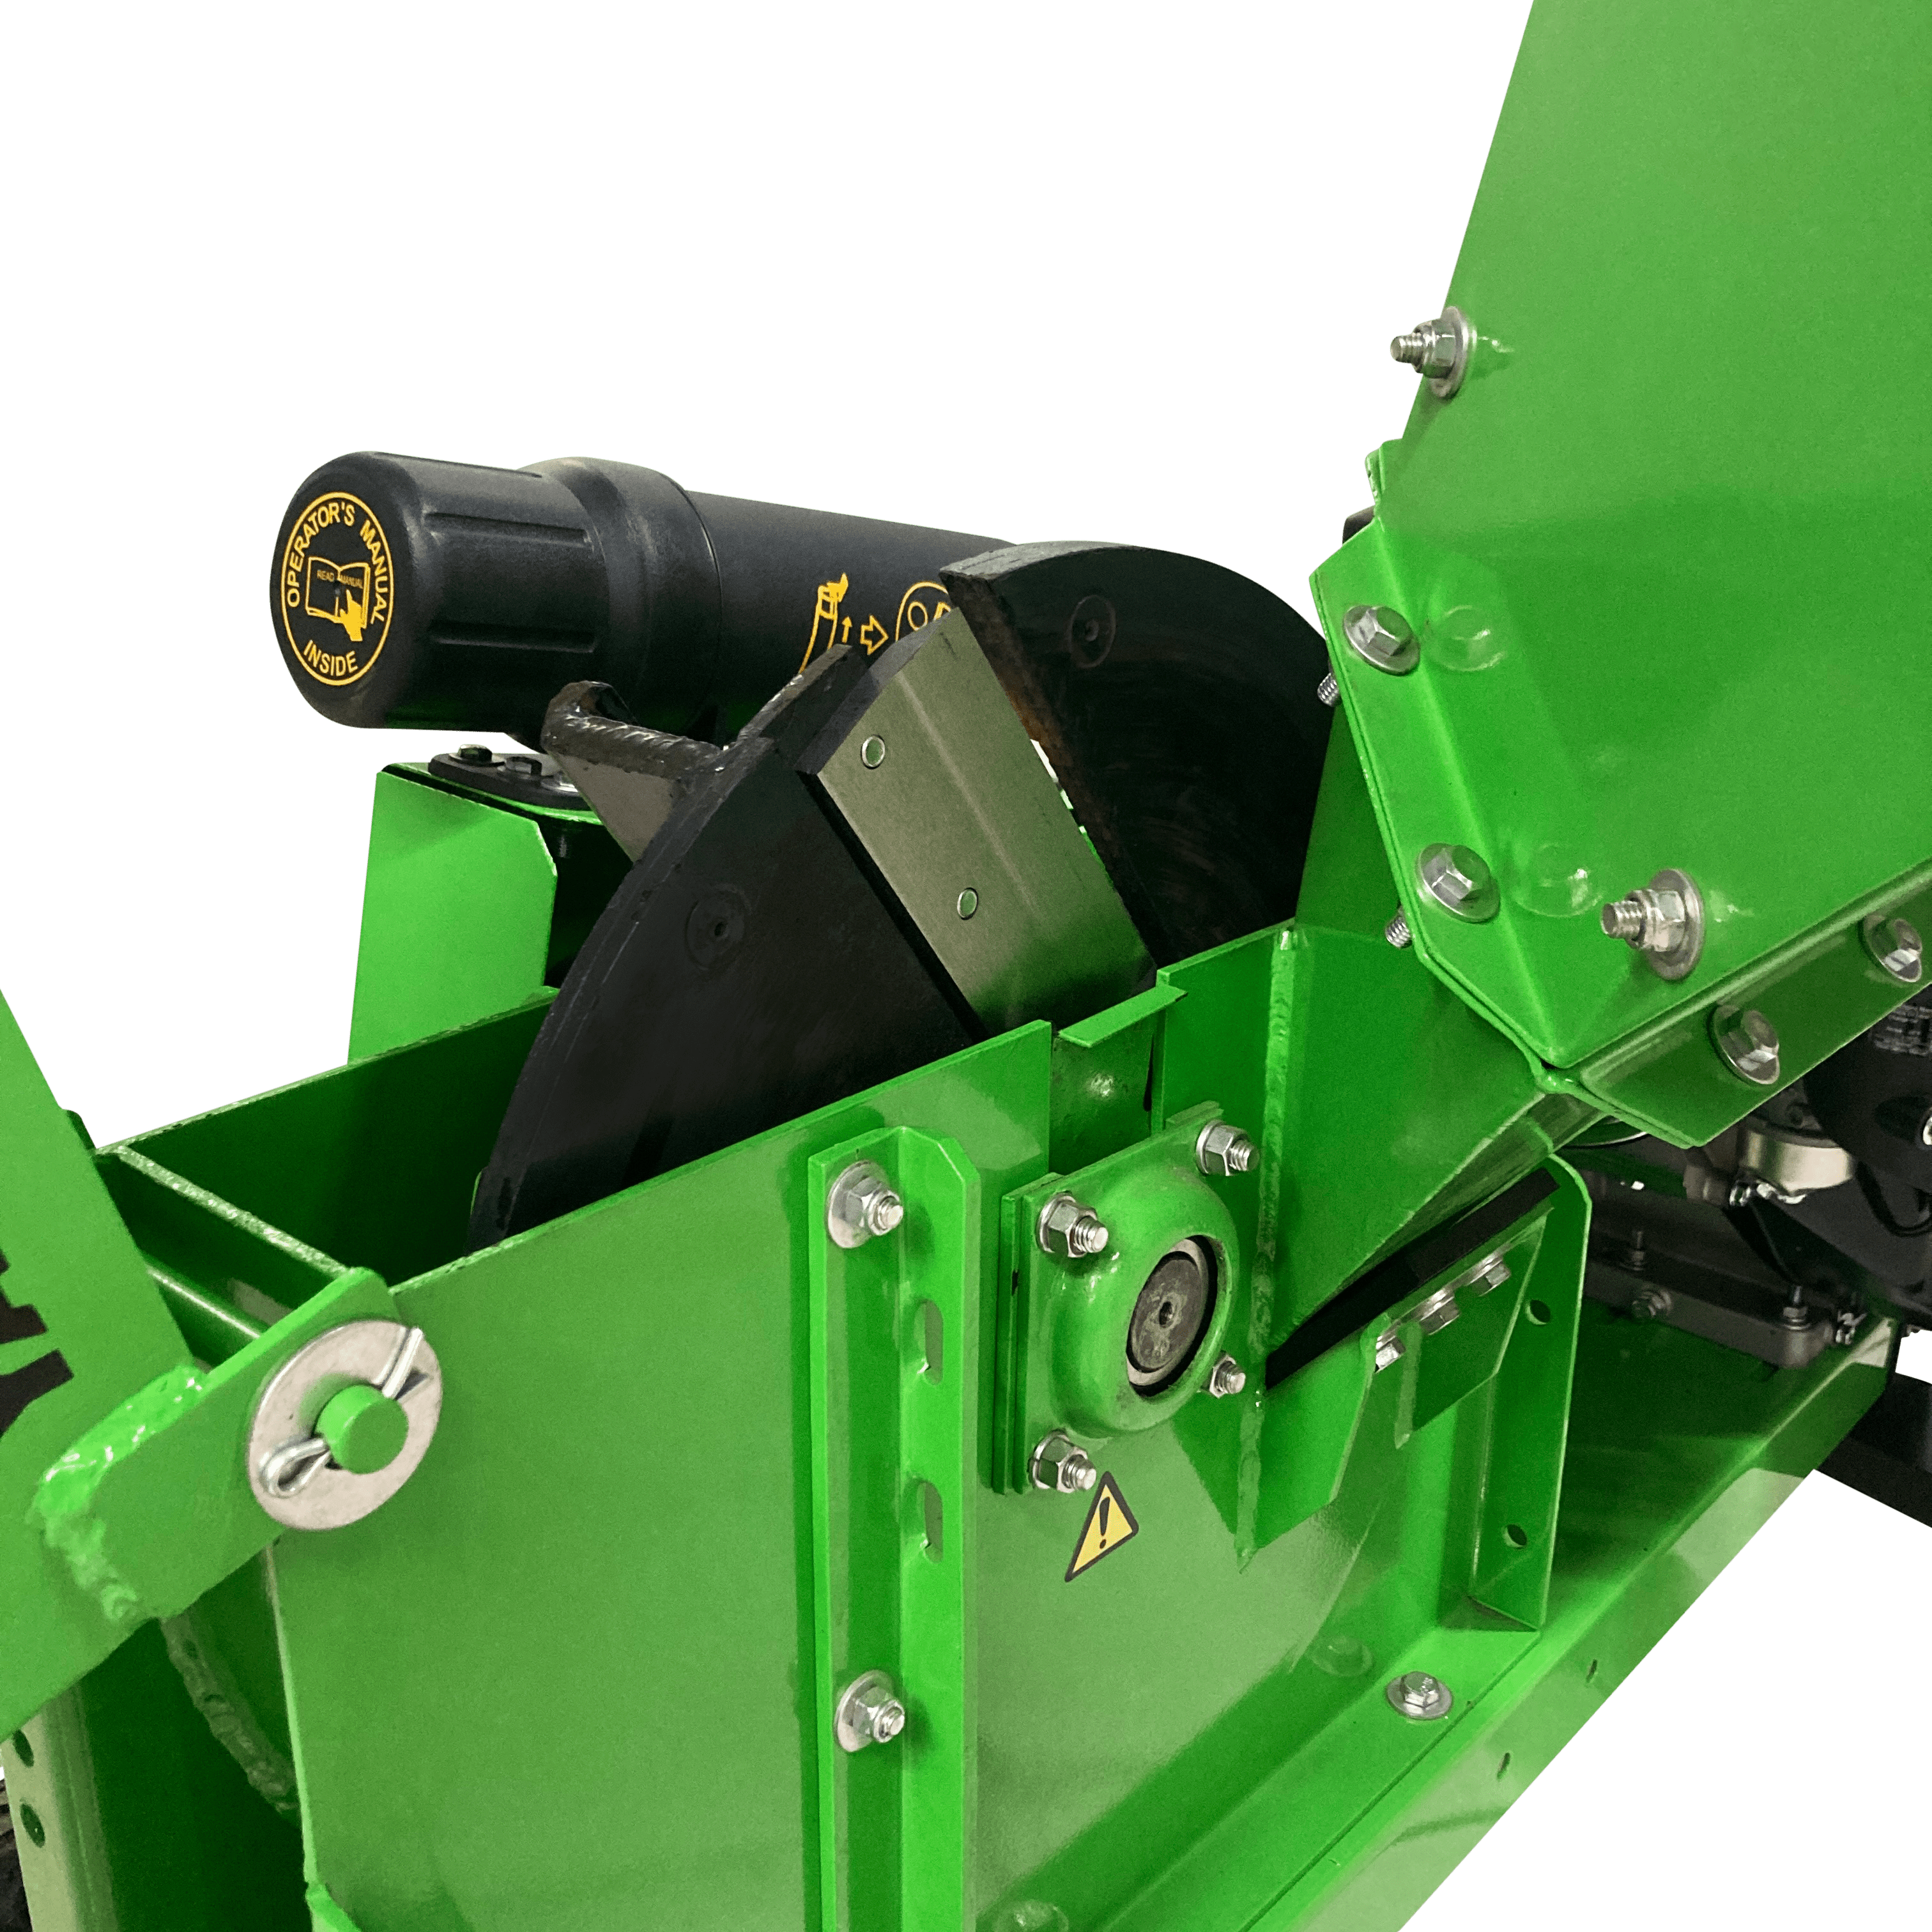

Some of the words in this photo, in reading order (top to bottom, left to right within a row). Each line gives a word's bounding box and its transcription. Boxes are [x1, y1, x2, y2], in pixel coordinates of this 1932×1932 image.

[287, 502, 355, 608] OPERATOR'S
[360, 519, 388, 625] MANUAL
[317, 569, 335, 582] READ
[303, 640, 358, 676] INSIDE
